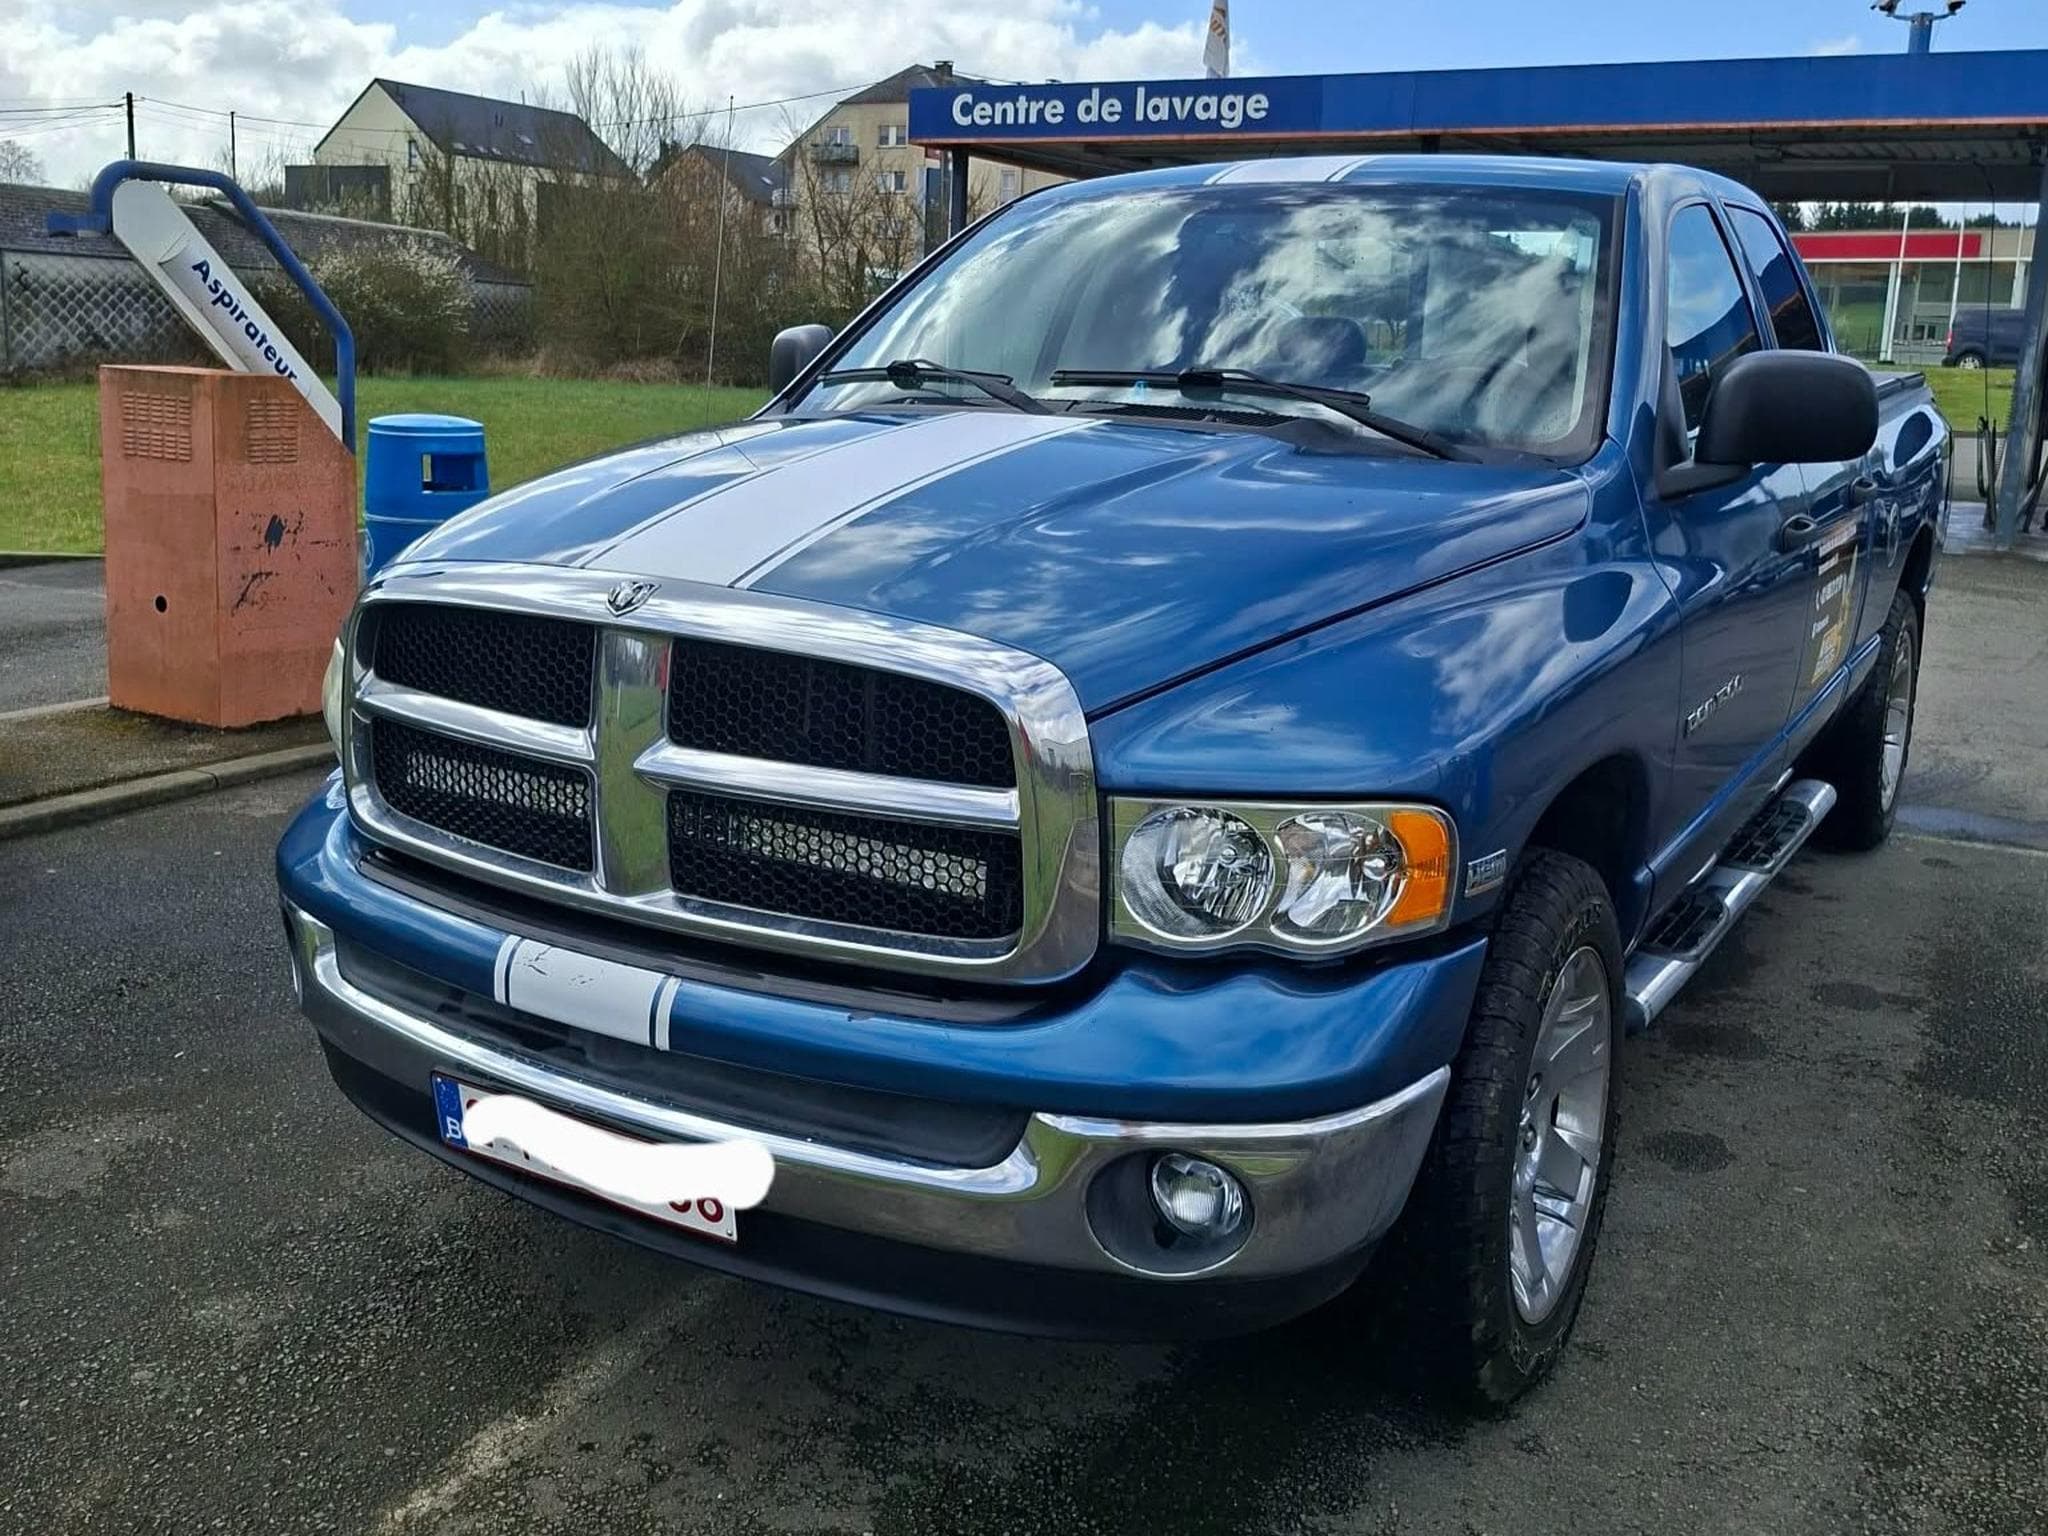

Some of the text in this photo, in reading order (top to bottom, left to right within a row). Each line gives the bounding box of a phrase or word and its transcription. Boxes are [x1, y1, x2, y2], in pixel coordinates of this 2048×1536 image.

[952, 87, 1270, 129] Centre de lavage
[192, 259, 298, 380] Aspirateur
[446, 1115, 462, 1139] B
